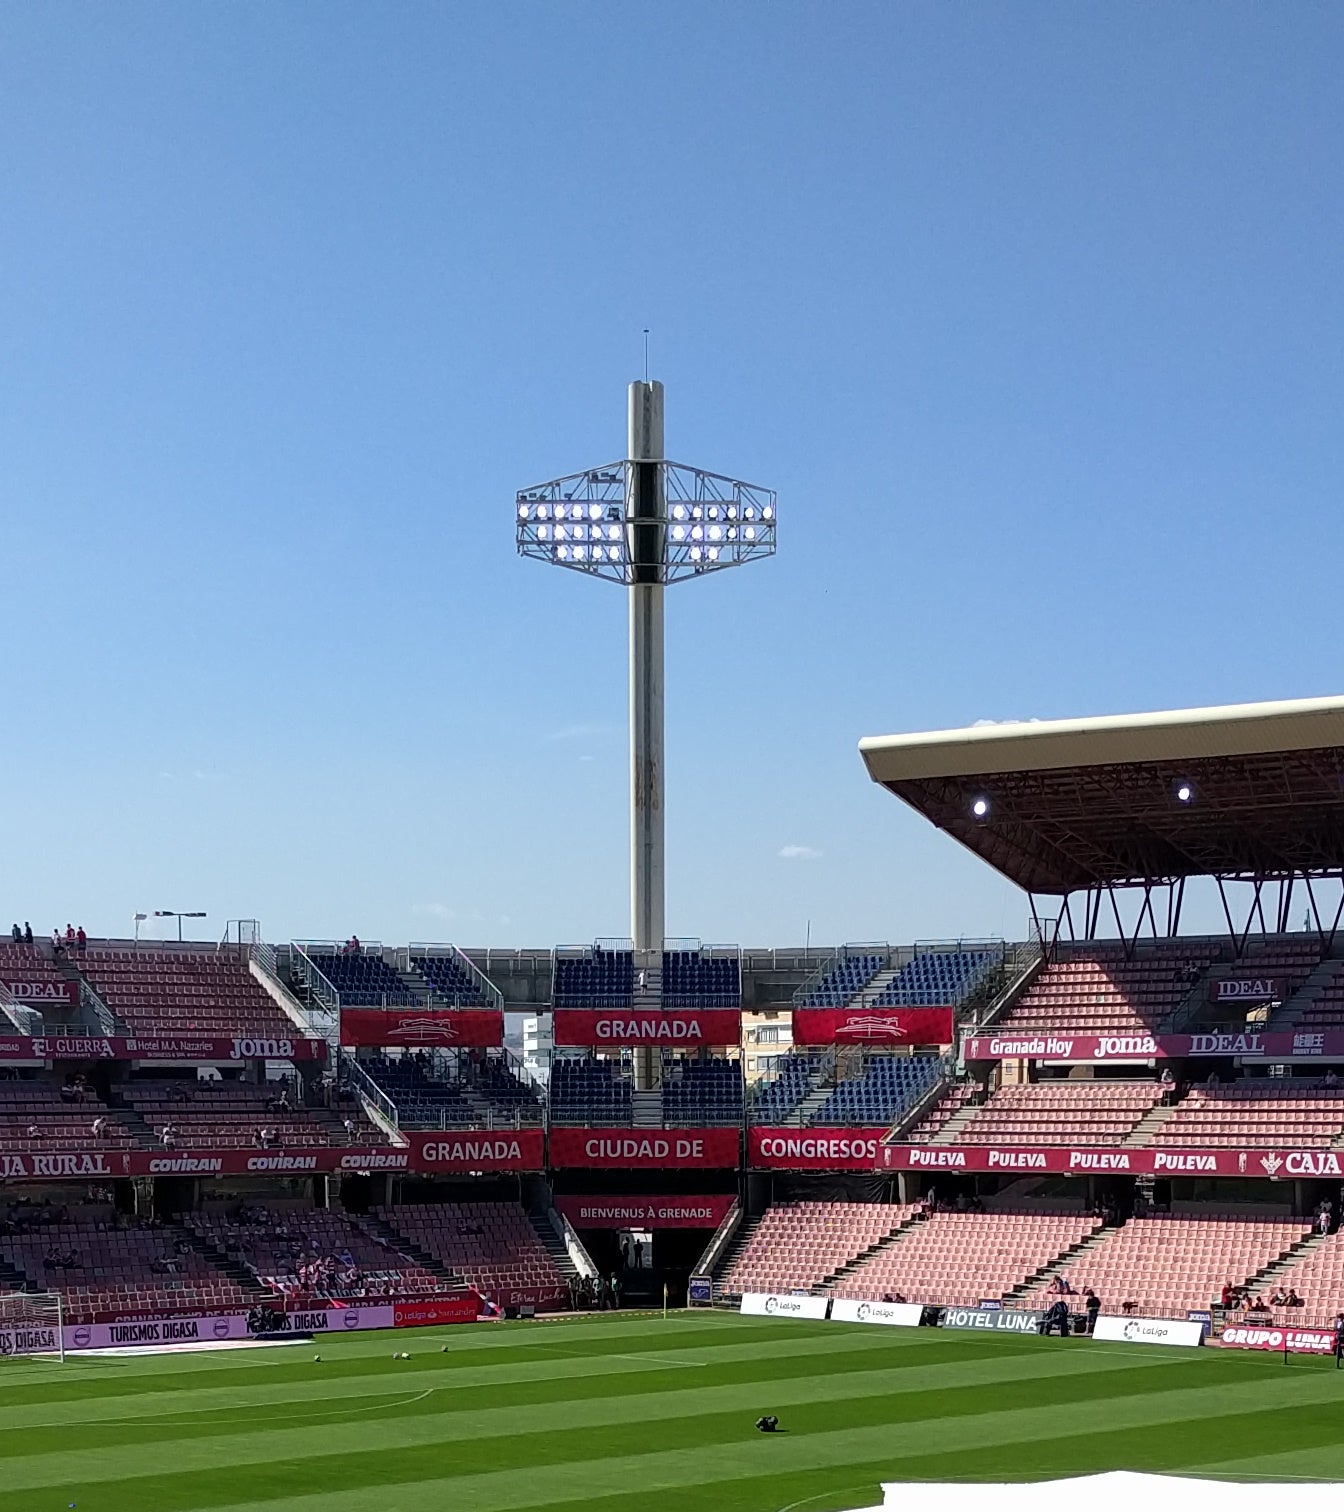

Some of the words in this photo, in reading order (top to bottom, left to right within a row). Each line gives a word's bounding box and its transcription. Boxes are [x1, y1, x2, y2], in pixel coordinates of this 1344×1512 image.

[12, 983, 70, 998] IDEAL
[1218, 980, 1276, 996] IDEAL
[596, 1020, 702, 1038] GRANADA
[32, 1038, 53, 1057] EL
[56, 1039, 115, 1057] GUERRA
[138, 1041, 159, 1051] Hotel
[990, 1037, 1046, 1055] Granada
[1047, 1037, 1073, 1058] Hoy
[1188, 1034, 1264, 1053] IDEAL
[422, 1141, 522, 1160] GRANADA
[585, 1139, 670, 1158] CIUDAD
[677, 1140, 704, 1157] DE
[760, 1139, 876, 1160] CONGRESOS
[33, 1154, 110, 1176] RURAL
[909, 1150, 966, 1167] PULEVA
[988, 1151, 1047, 1168] PULEVA
[1069, 1152, 1130, 1169] PULEVA
[1154, 1153, 1217, 1170] PULEVA
[1285, 1154, 1342, 1176] CAJA
[580, 1207, 645, 1219] BIENVENUS
[648, 1205, 656, 1219] À
[658, 1207, 712, 1219] GRENADE
[294, 1313, 328, 1331] DIGASA
[945, 1311, 994, 1328] HOTEL
[997, 1313, 1037, 1330] LUNA
[16, 1328, 55, 1348] DIGASA
[108, 1325, 160, 1344] TURISMOS
[163, 1322, 199, 1340] DIGASA
[1222, 1328, 1287, 1347] GRUPO
[1291, 1331, 1335, 1350] LUNA
